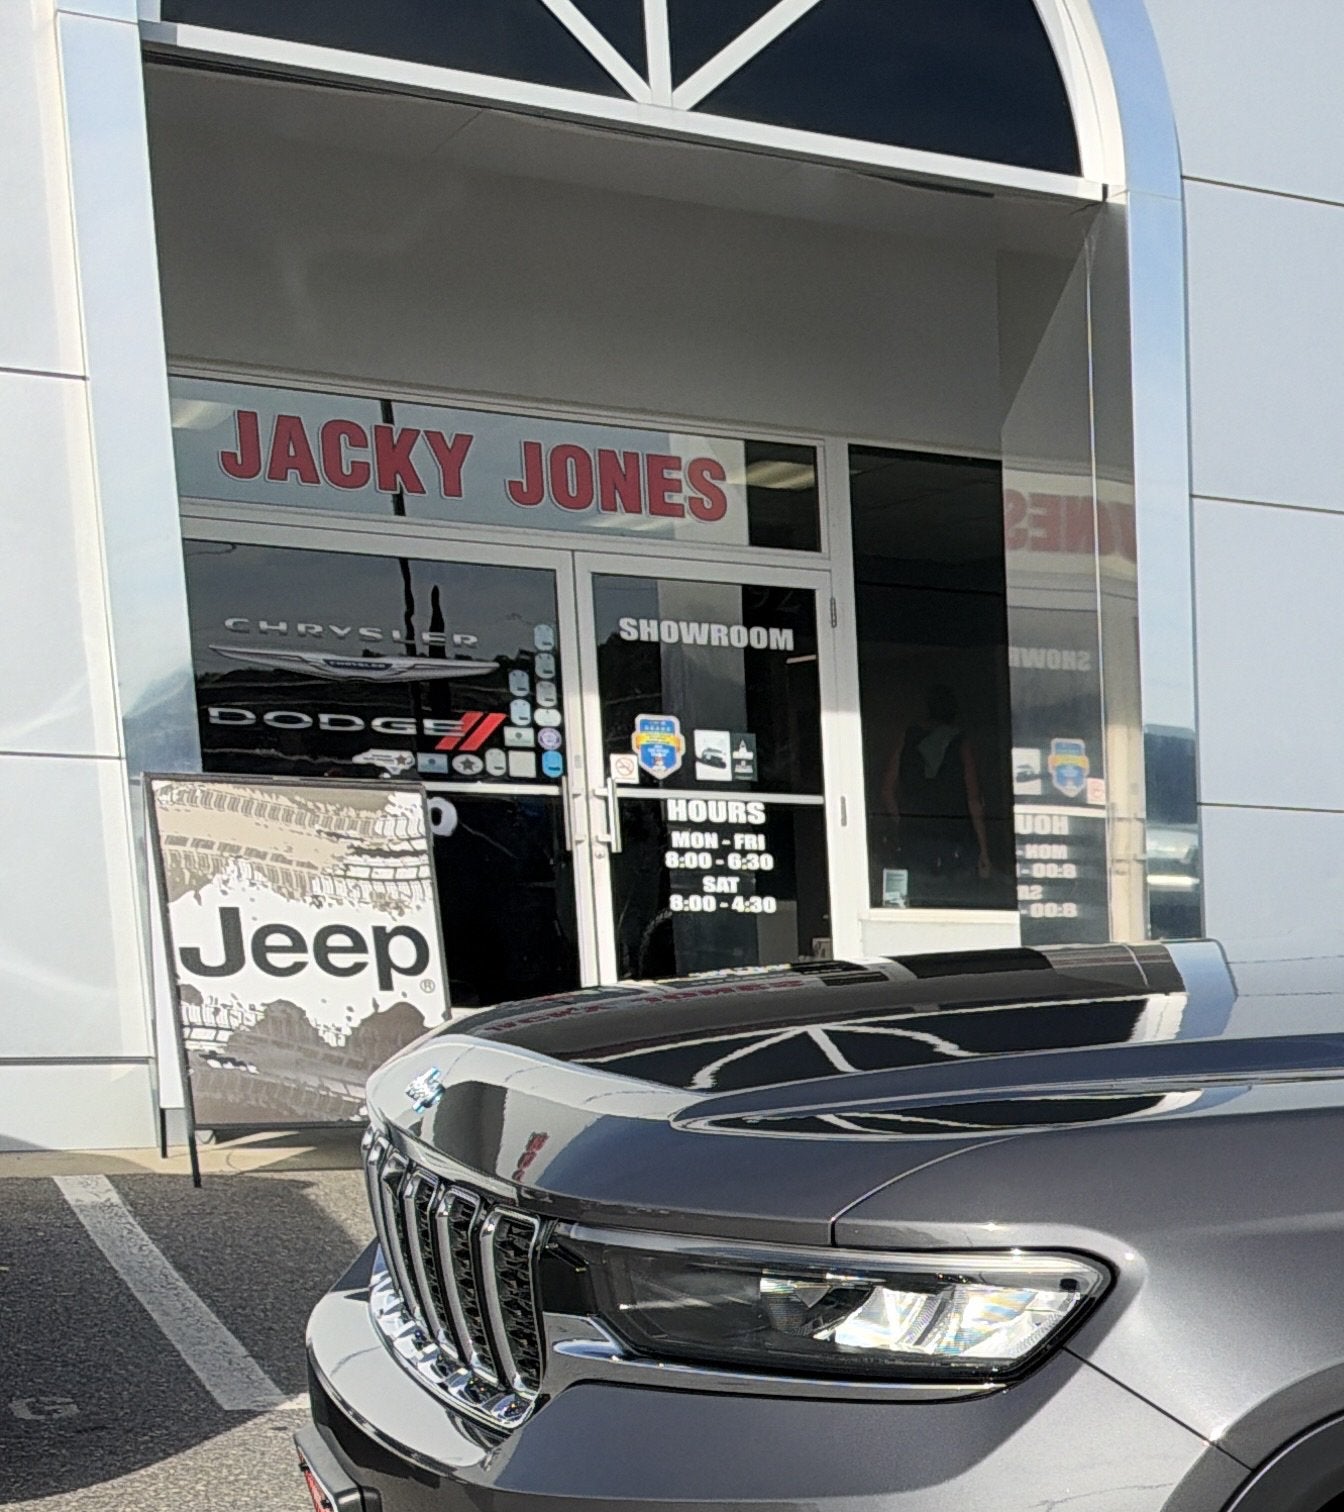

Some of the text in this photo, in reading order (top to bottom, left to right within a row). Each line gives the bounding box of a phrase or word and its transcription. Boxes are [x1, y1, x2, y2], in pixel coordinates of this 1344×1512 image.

[219, 409, 727, 521] JACKY JONES
[224, 618, 479, 647] CHRYSLER
[618, 617, 794, 651] SHOWROOM
[208, 707, 466, 737] DODGE
[667, 799, 766, 824] HOURS
[671, 831, 719, 849] MON
[734, 833, 766, 851] FRI
[665, 851, 712, 869] 8:00
[727, 853, 774, 870] 6:30
[702, 876, 740, 893] SAT
[731, 896, 777, 913] 4:30
[179, 906, 430, 992] Jeep
